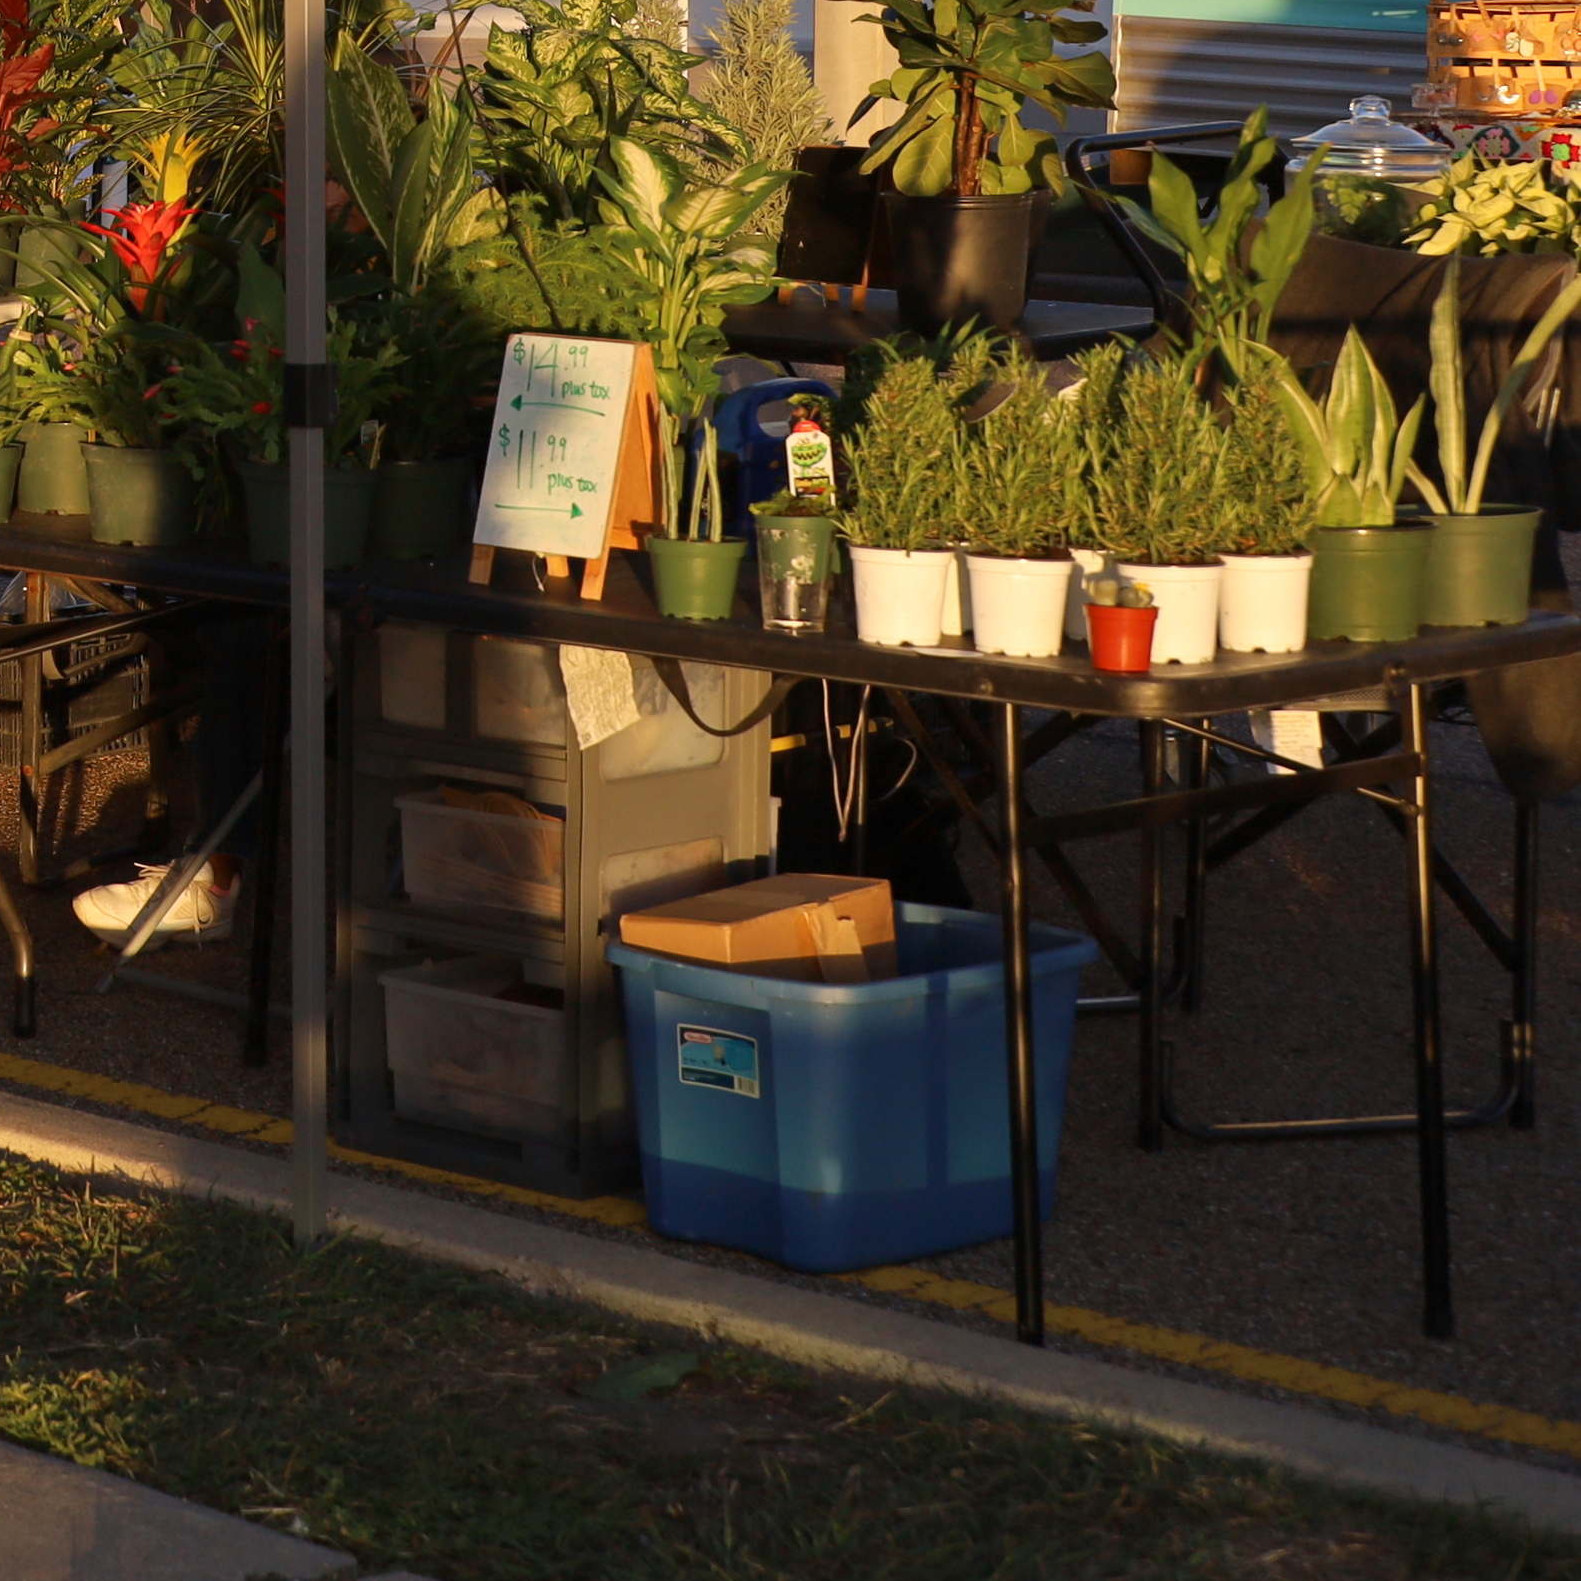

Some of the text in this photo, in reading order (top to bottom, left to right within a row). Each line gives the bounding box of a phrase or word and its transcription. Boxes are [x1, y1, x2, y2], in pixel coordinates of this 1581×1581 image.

[561, 380, 612, 400] plus tax
[547, 472, 599, 496] plus tax
